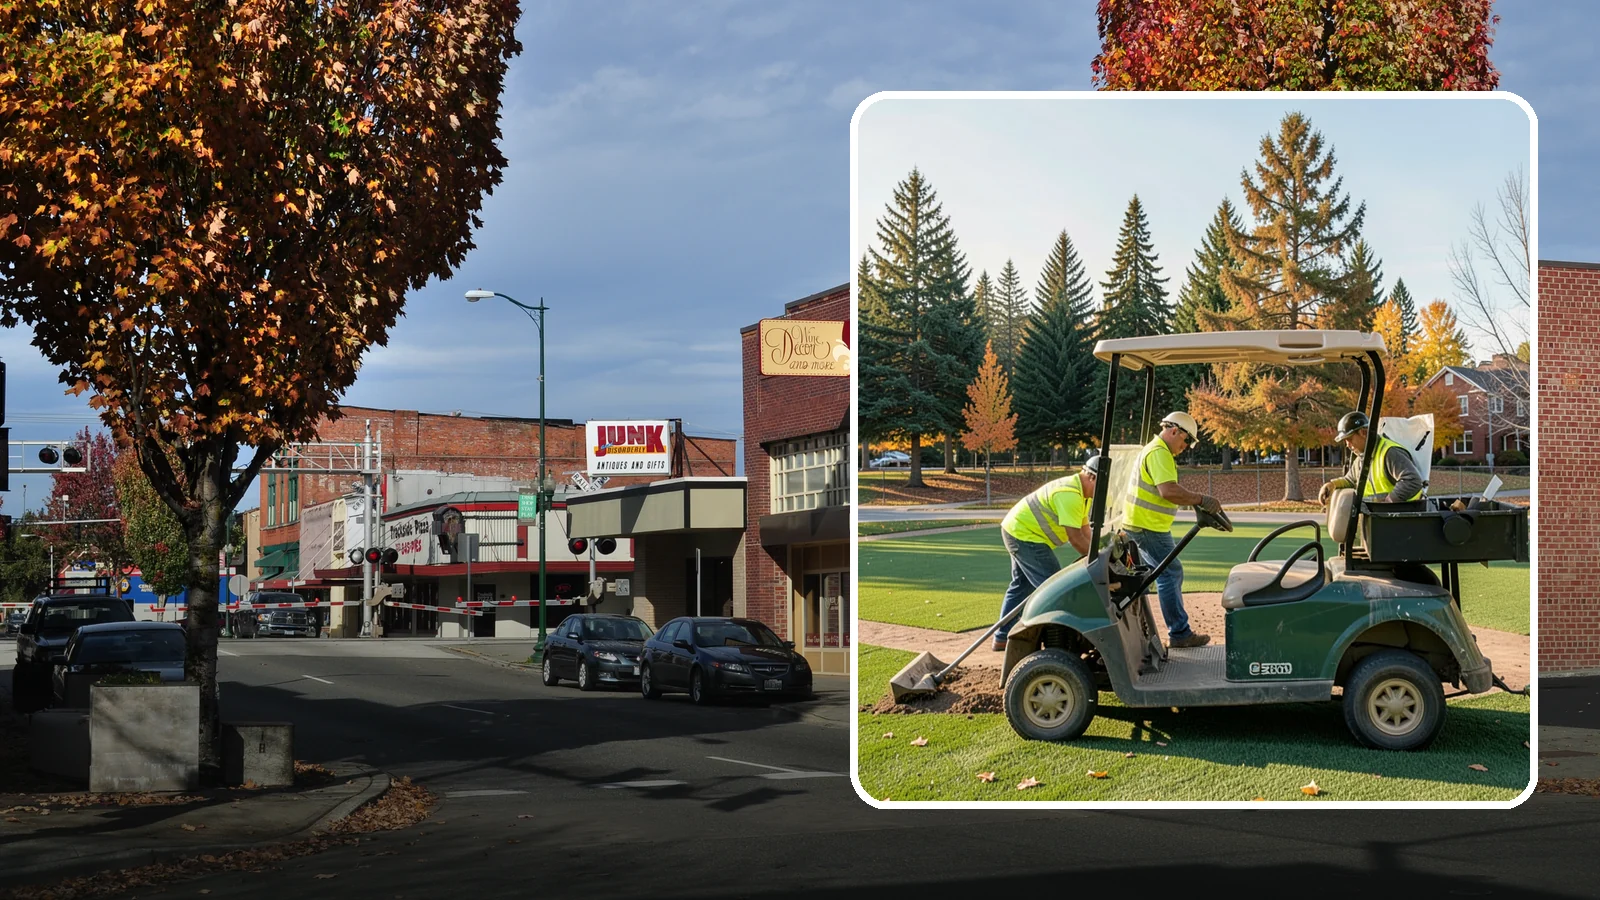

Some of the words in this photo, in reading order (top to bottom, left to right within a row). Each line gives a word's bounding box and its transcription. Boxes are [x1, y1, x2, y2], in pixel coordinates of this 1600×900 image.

[595, 425, 665, 457] JUNK
[607, 446, 646, 454] DISORDERLY
[597, 461, 628, 470] ANTIQUES
[631, 461, 644, 470] AND
[647, 460, 665, 469] GIFTS
[390, 521, 413, 540] Trackside
[414, 519, 429, 535] Pizza
